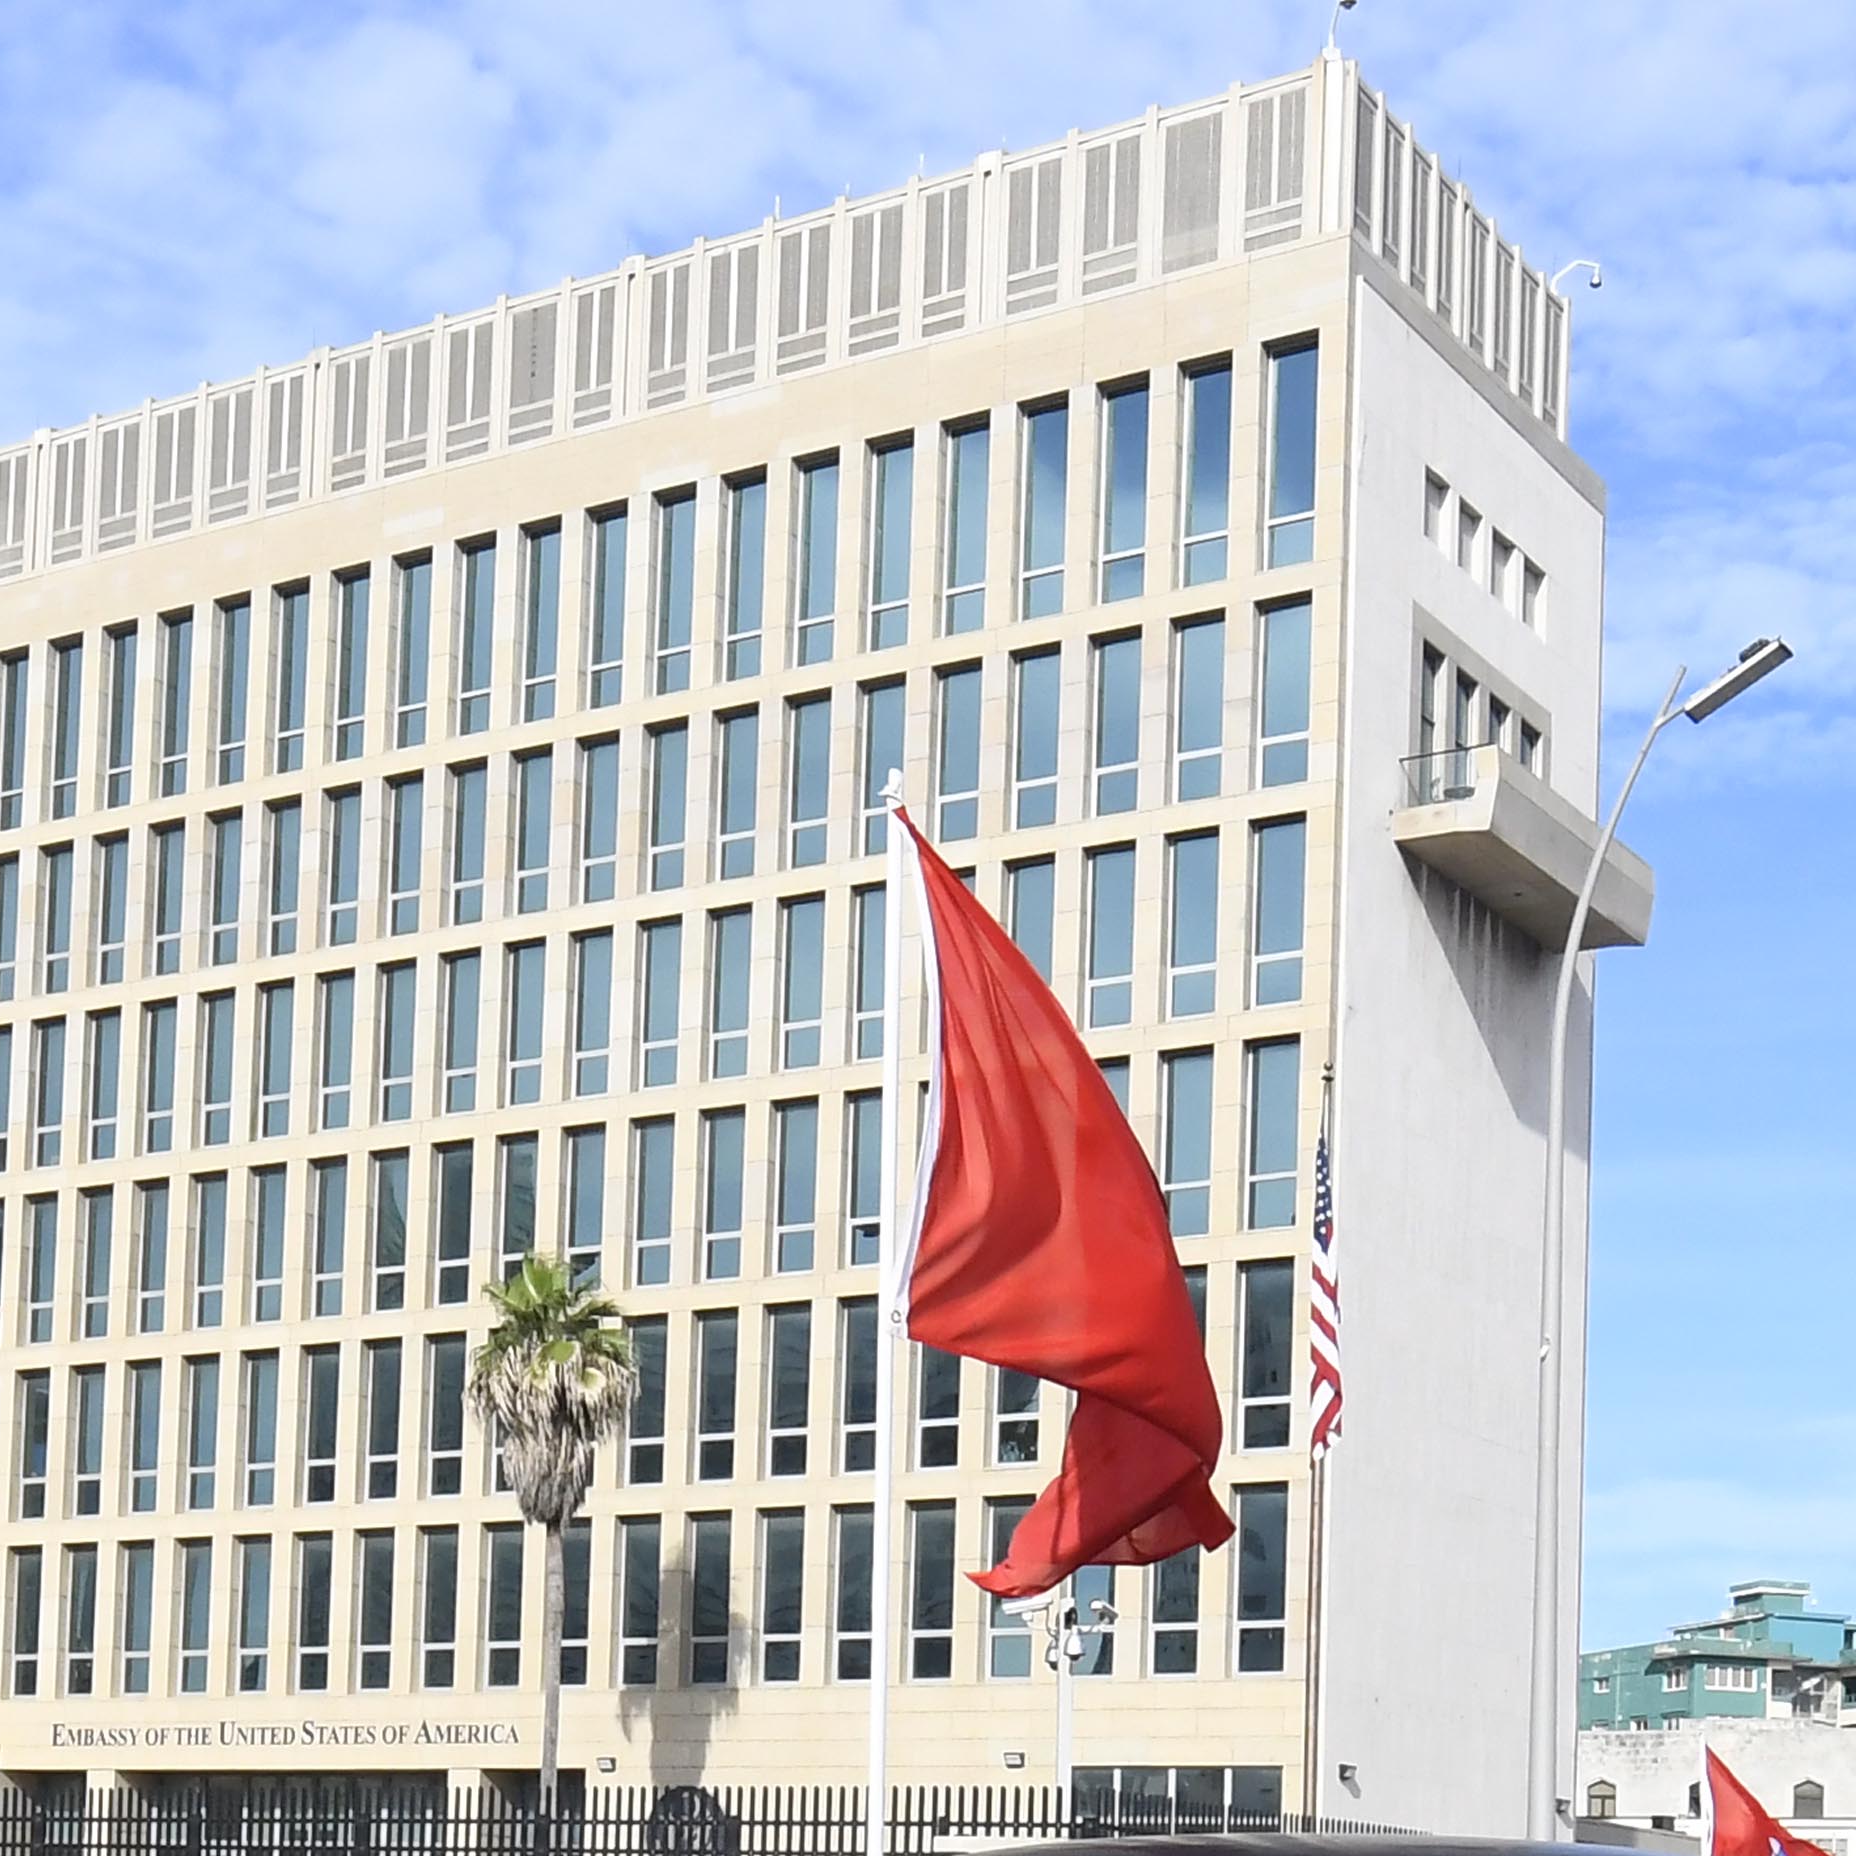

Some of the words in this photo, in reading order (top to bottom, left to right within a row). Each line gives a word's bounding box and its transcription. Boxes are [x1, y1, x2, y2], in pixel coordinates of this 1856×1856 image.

[145, 1726, 171, 1747] OF
[174, 1727, 213, 1746] THE
[218, 1721, 296, 1746] UNITED
[300, 1720, 377, 1746] STATES
[381, 1725, 410, 1745] OF
[414, 1719, 520, 1745] AMERICA
